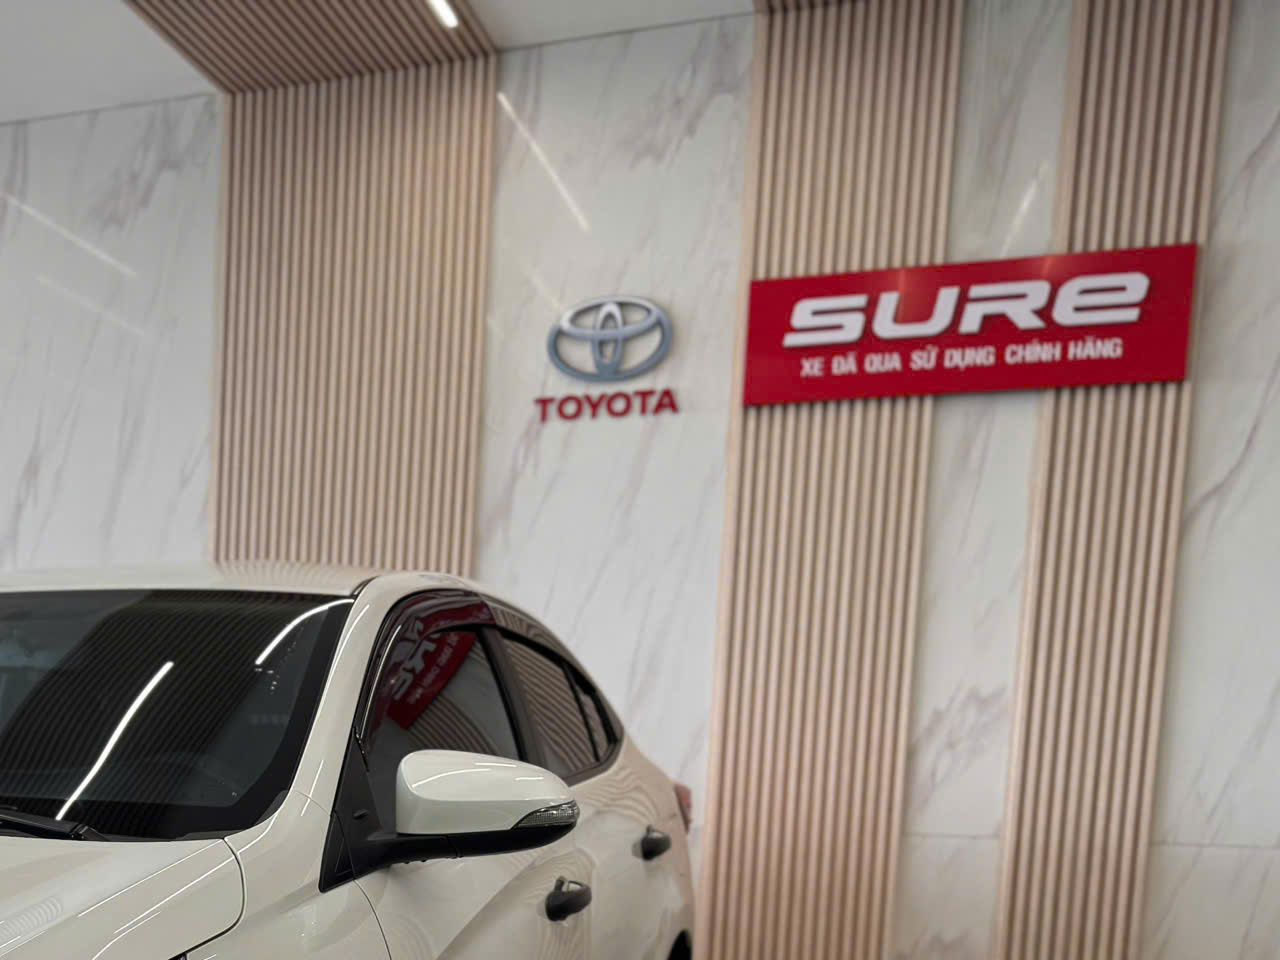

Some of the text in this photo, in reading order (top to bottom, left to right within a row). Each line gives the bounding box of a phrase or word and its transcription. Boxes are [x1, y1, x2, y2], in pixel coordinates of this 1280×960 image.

[800, 356, 824, 377] XE
[832, 354, 857, 375] ĐÃ
[864, 351, 902, 374] QUA
[944, 345, 996, 371] DỤNG
[1004, 338, 1062, 364] CHÍNH
[1067, 335, 1123, 360] HÃNG
[534, 389, 679, 424] TOYOTA
